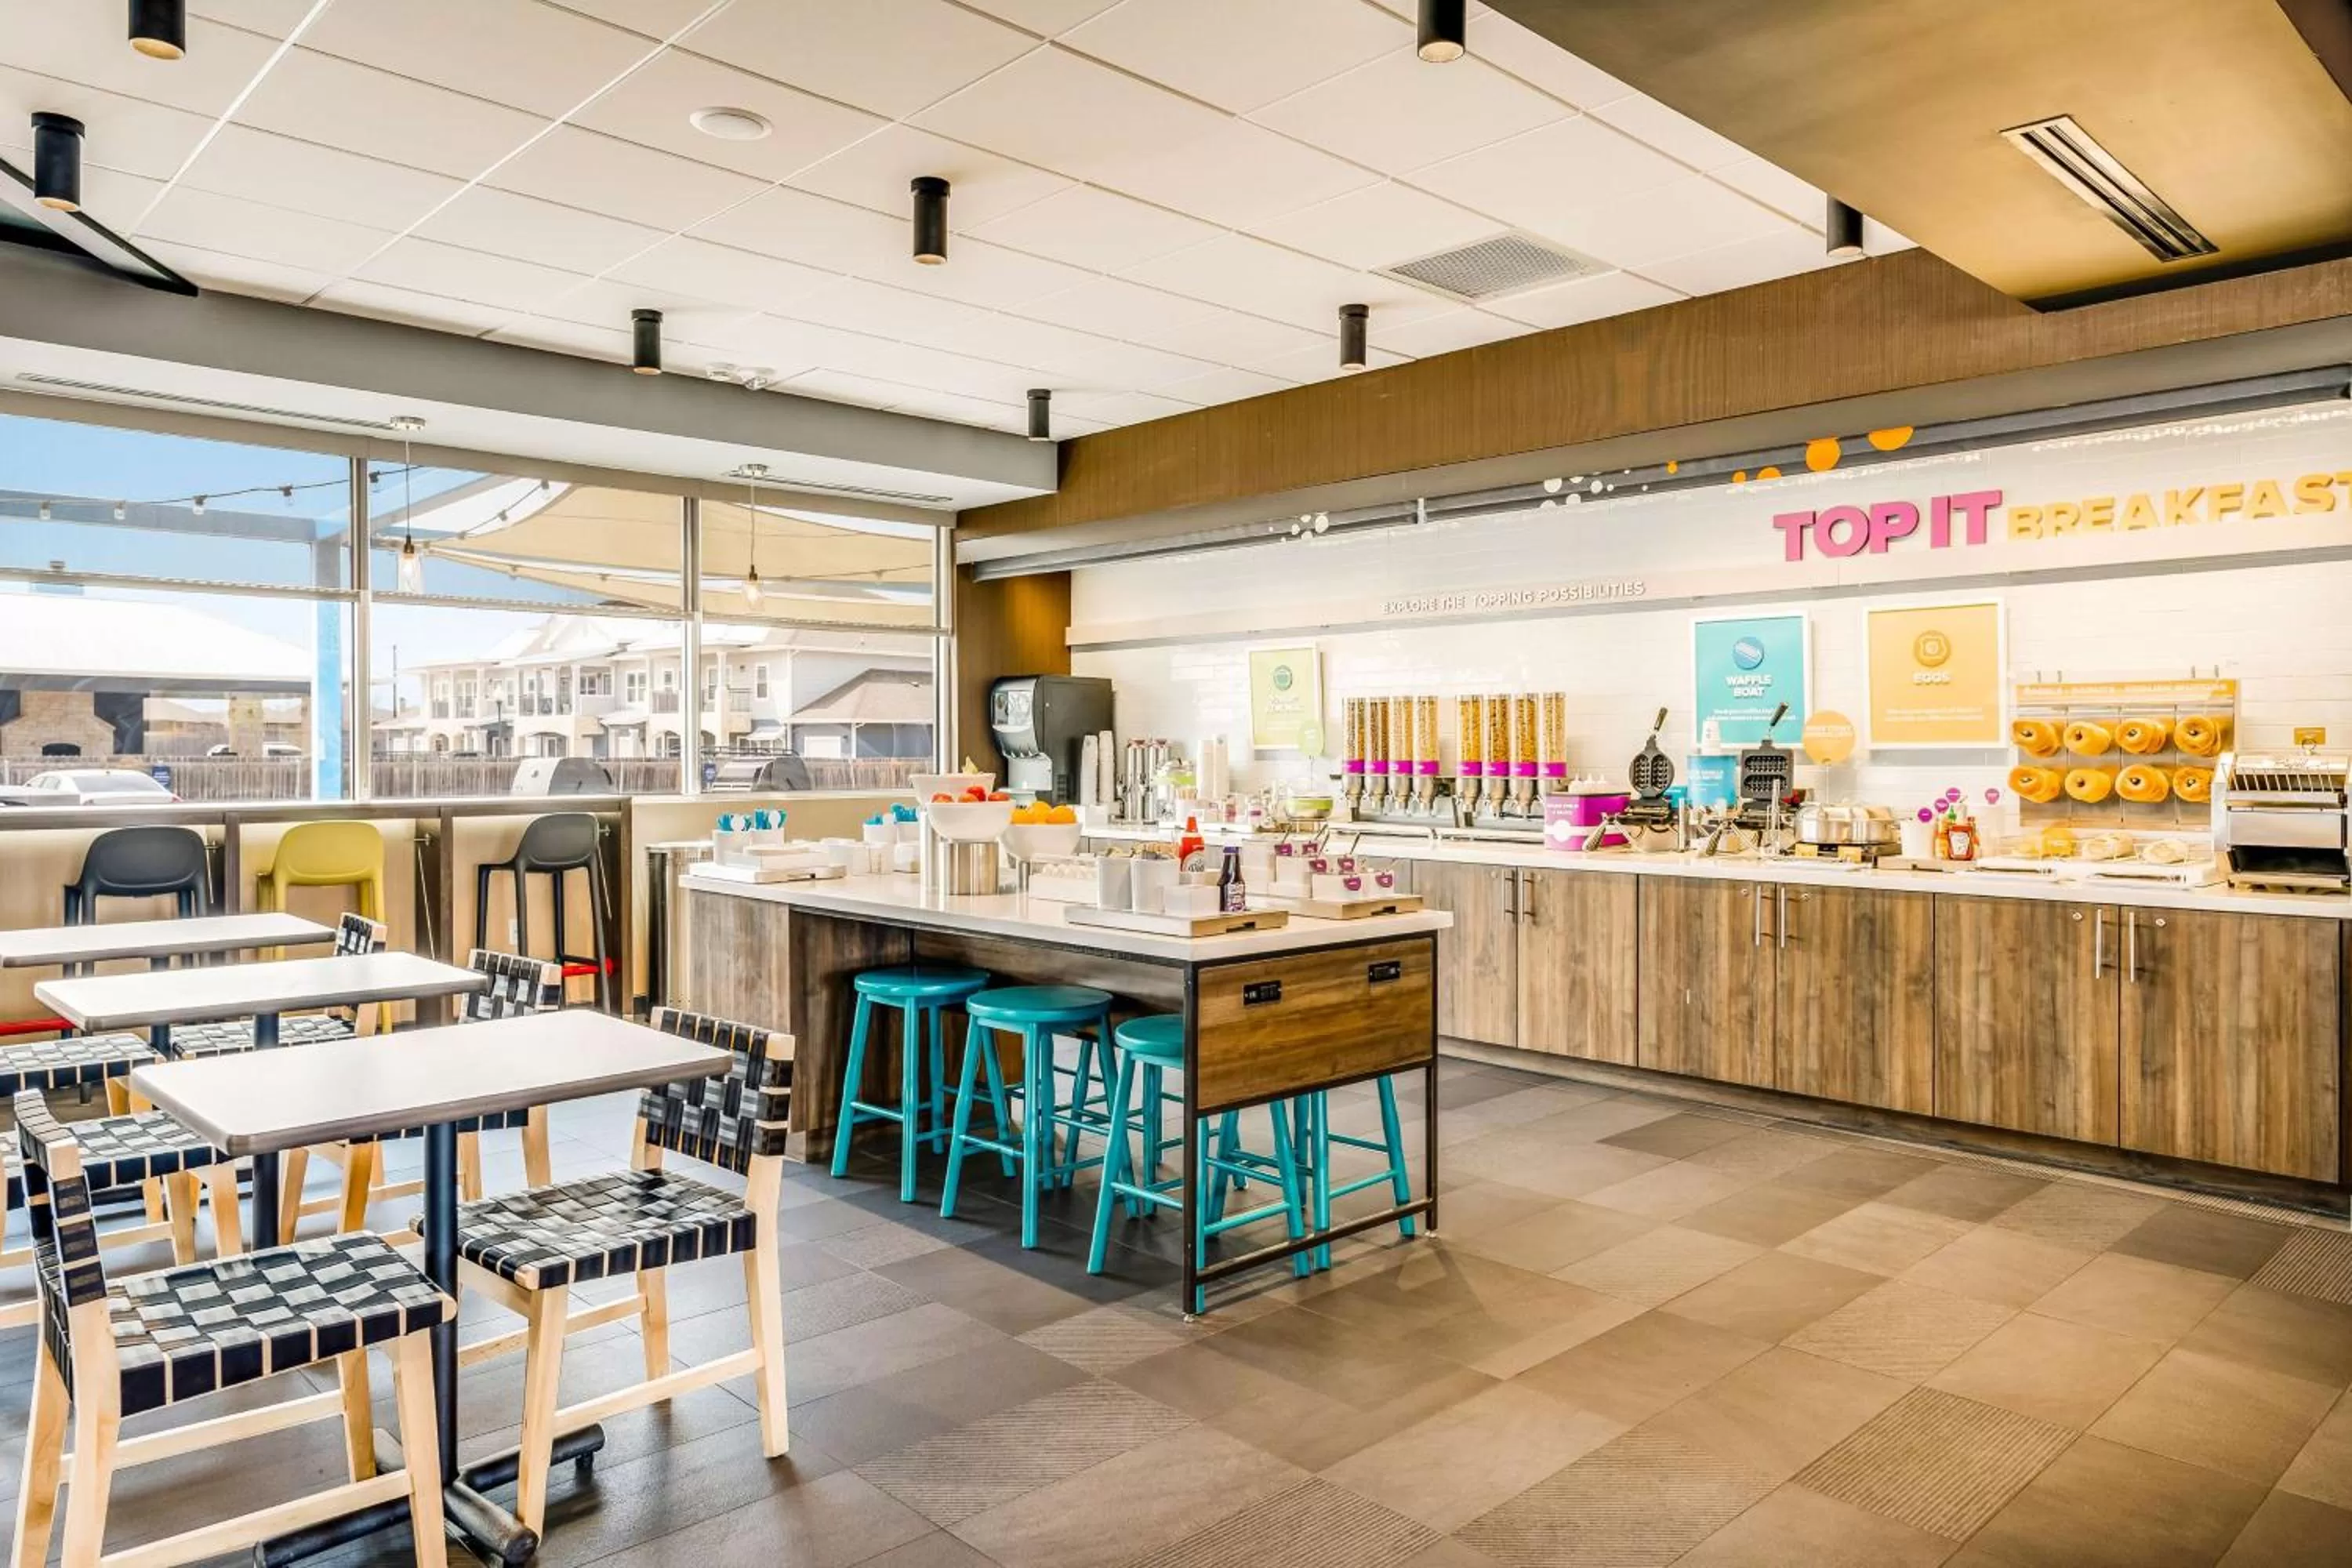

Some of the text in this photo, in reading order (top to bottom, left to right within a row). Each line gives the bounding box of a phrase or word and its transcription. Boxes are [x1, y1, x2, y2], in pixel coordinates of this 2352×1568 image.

[1773, 501, 1920, 562] TOP
[1930, 490, 2003, 550] IT
[1382, 580, 1646, 615] EXPLORE THE TOPPING POSSIBILITIES
